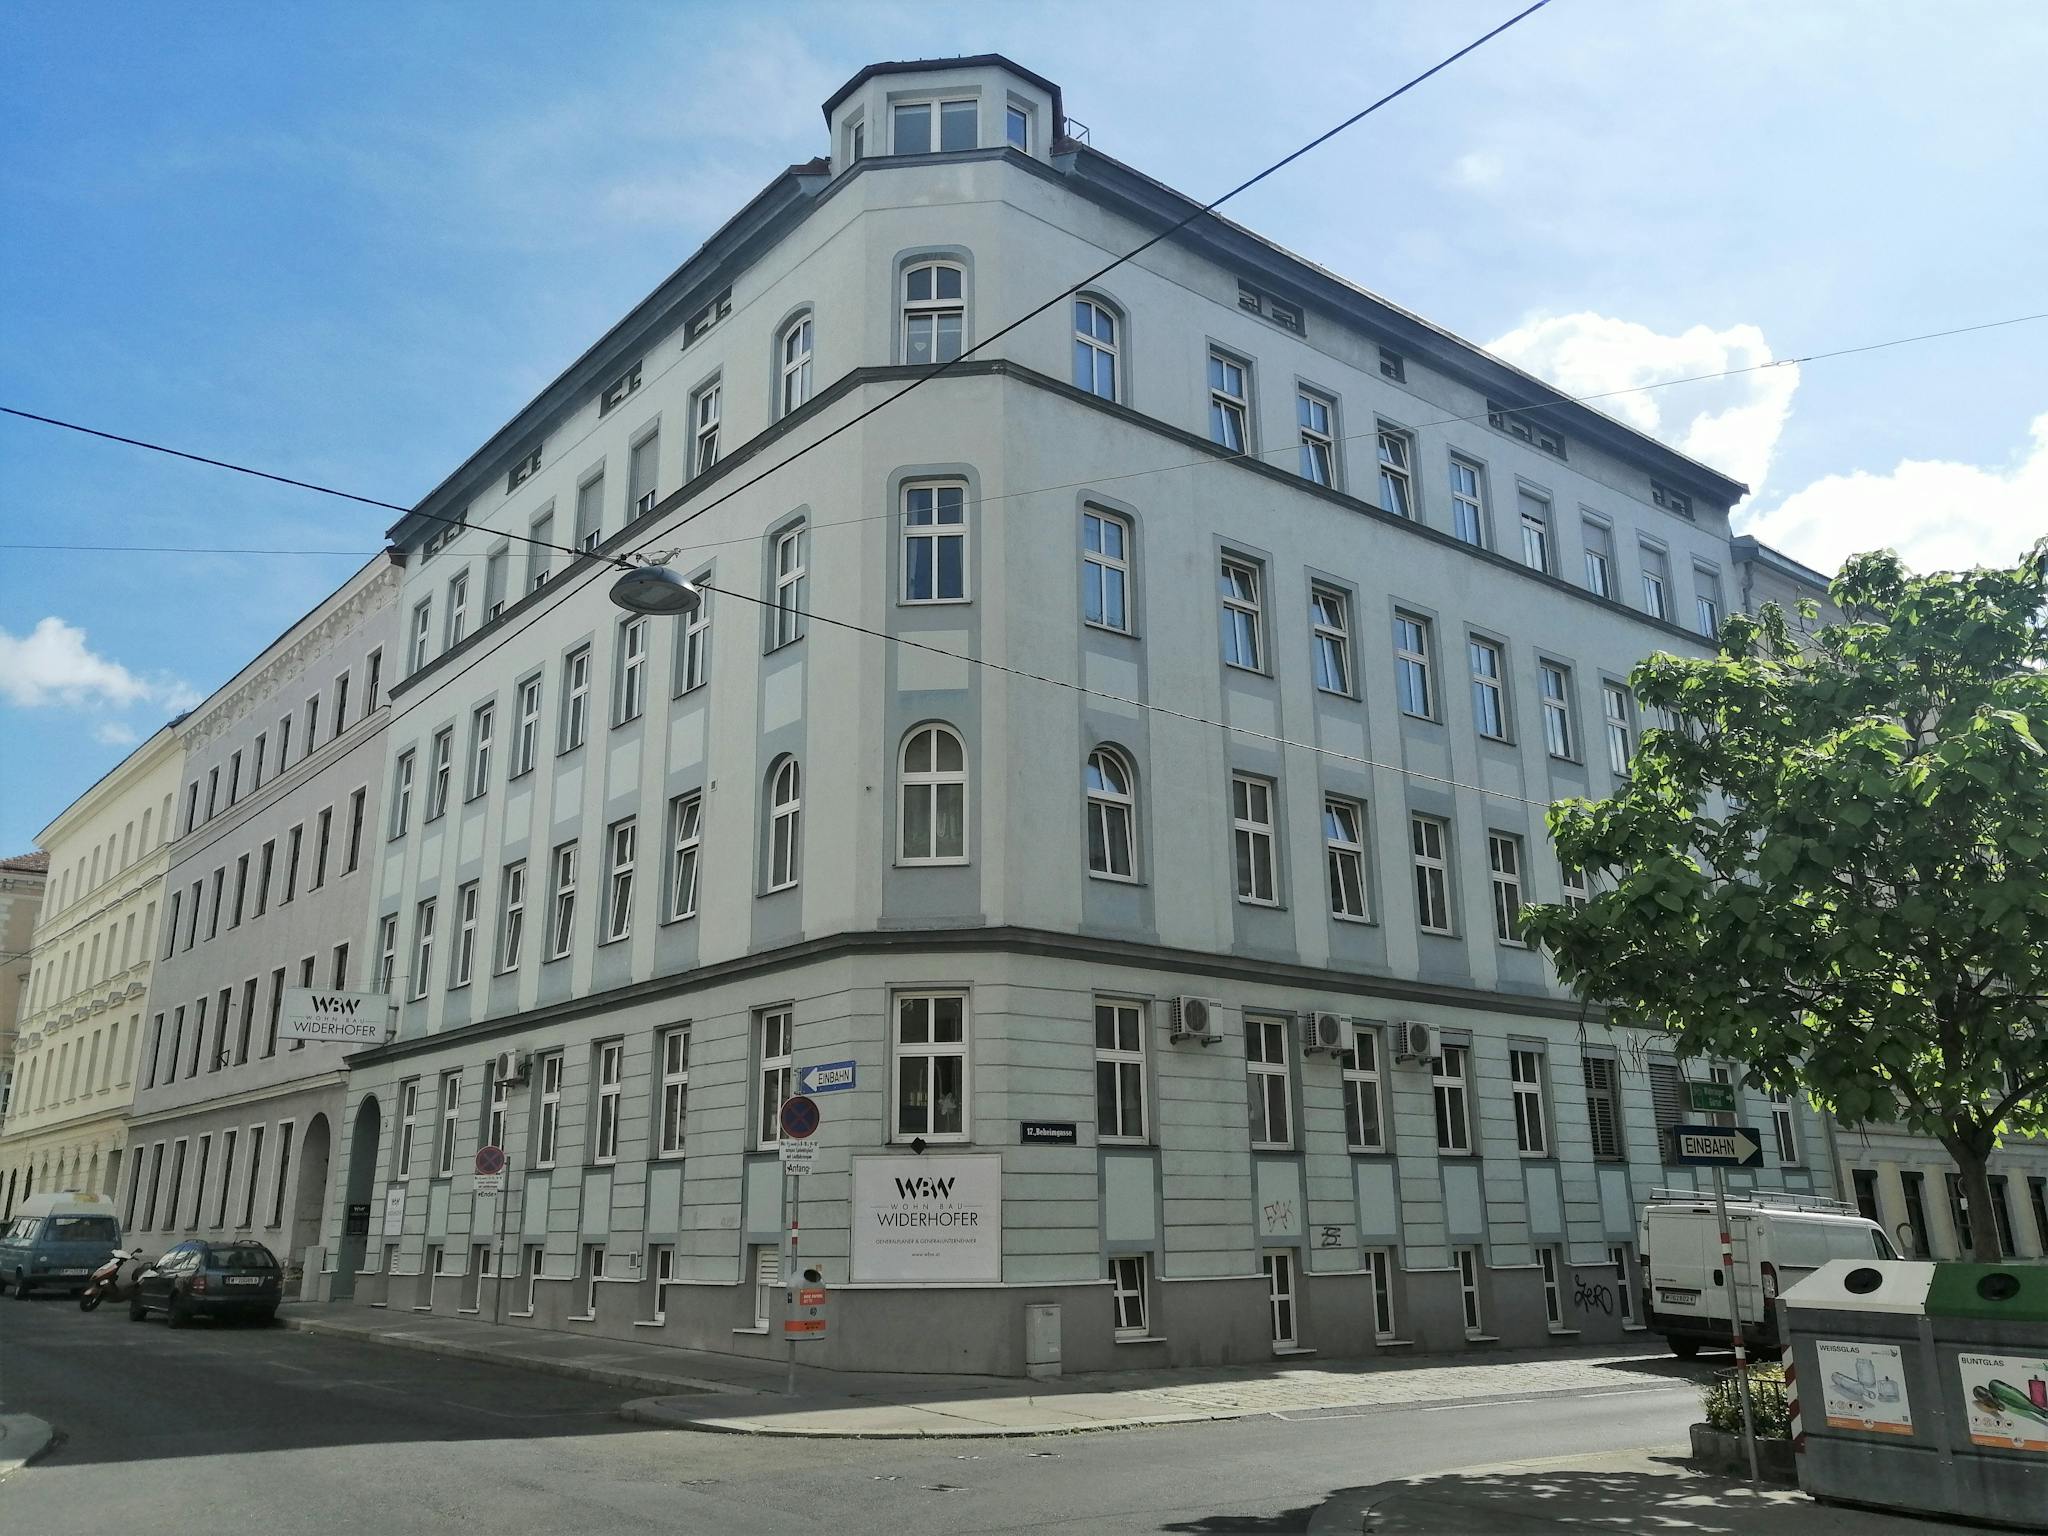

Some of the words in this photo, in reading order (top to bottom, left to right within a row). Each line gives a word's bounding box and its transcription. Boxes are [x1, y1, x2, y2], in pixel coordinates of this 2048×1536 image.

[293, 1021, 376, 1036] WIDERHOFER
[818, 1069, 850, 1085] EINBAHN
[1685, 1137, 1735, 1155] EINBAHN
[876, 1212, 979, 1227] WIDERHOFER
[1819, 1345, 1860, 1354] WEISSGLAS
[1961, 1357, 2005, 1367] BUNTGLAS
